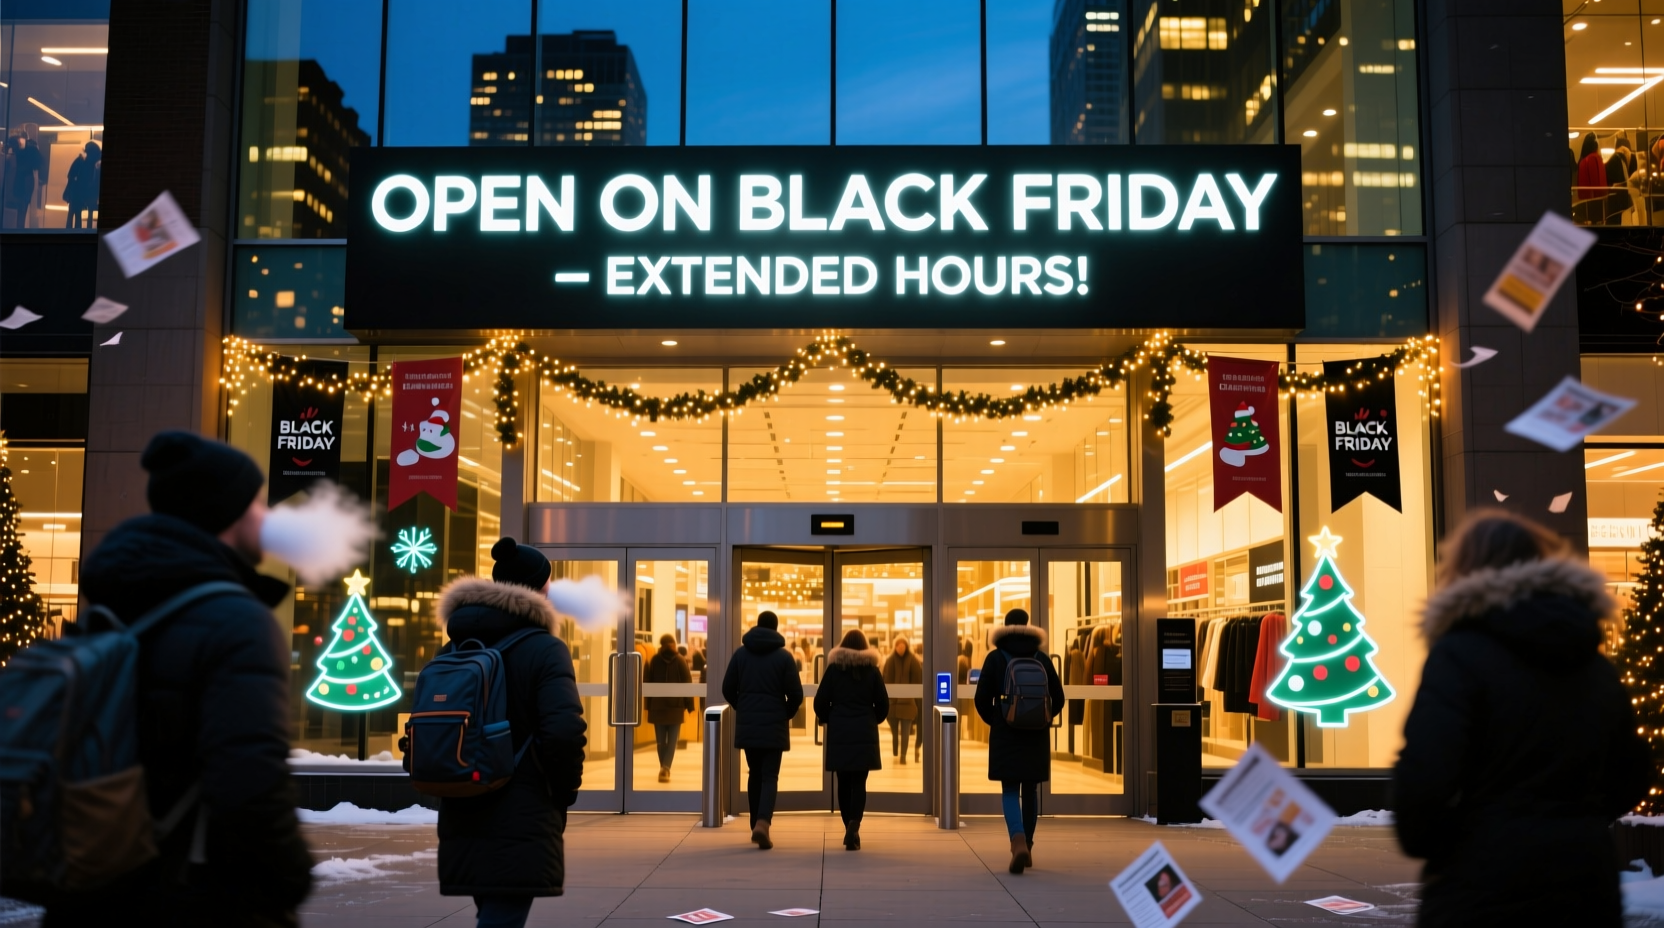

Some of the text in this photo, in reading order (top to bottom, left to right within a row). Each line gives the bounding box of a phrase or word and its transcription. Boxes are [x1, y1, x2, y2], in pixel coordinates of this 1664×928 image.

[371, 173, 1278, 233] OPEN ON BLACK FRIDAY
[606, 255, 878, 296] EXTENDED
[895, 254, 1090, 296] HOURS!
[279, 420, 333, 435] BLACK
[1335, 420, 1388, 435] BLACK
[277, 436, 335, 450] FRIDAY
[1335, 437, 1392, 451] FRIDAY
